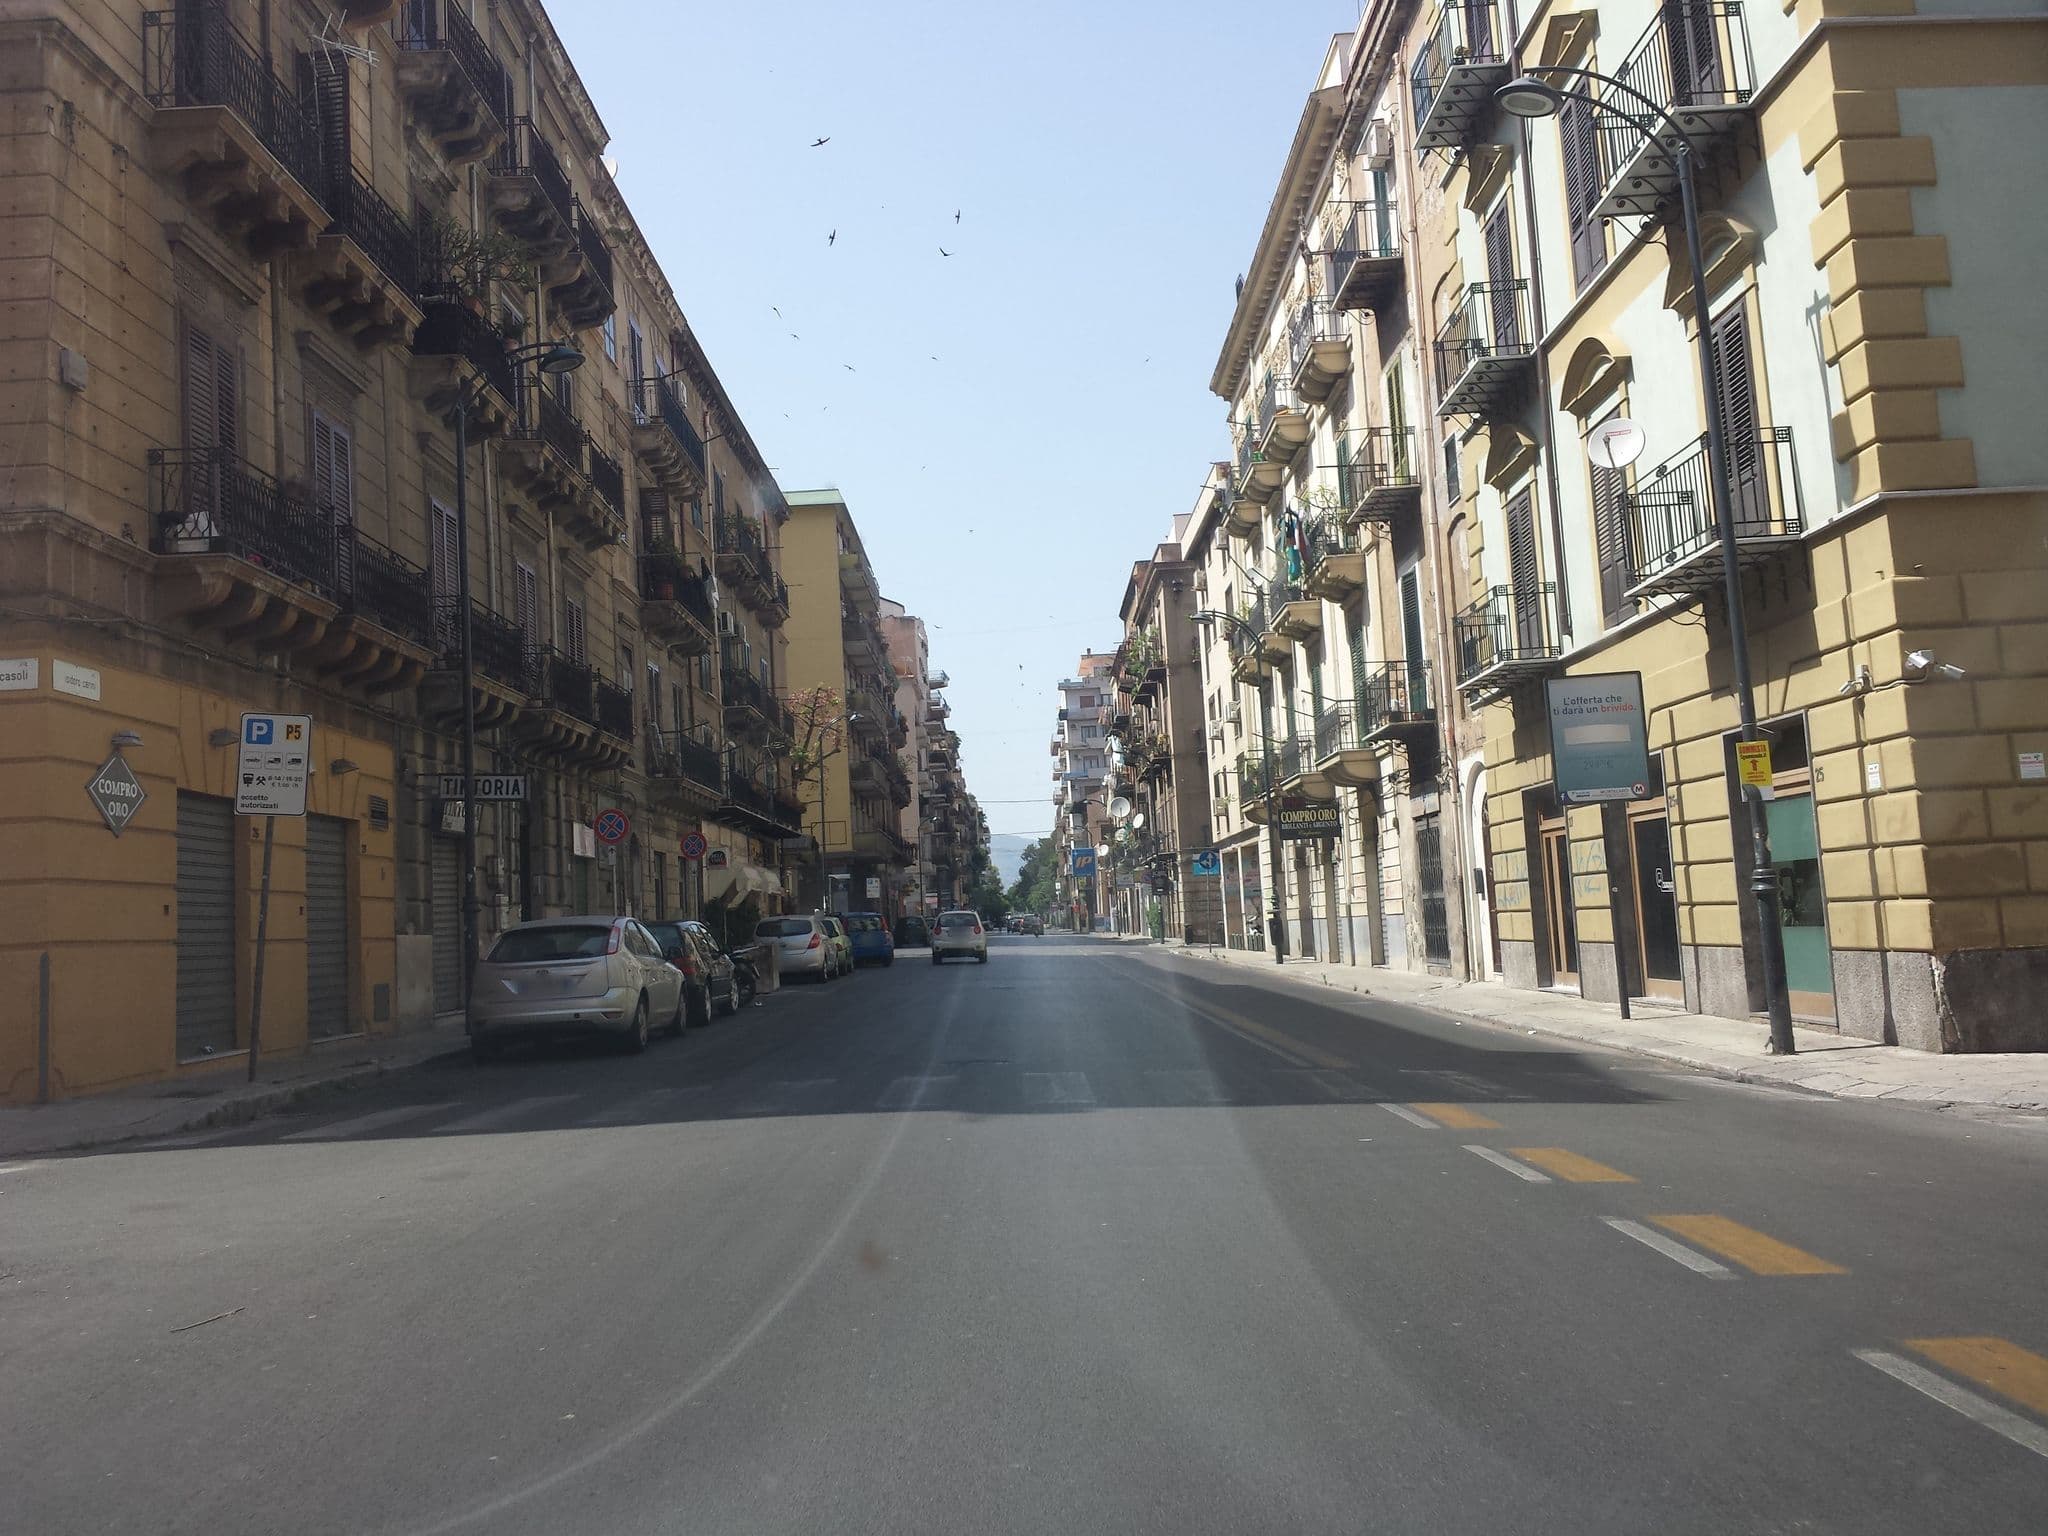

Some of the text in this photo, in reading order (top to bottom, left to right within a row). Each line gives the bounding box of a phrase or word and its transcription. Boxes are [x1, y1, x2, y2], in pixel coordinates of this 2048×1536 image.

[1563, 694, 1622, 706] L'offerta che
[1553, 708, 1560, 716] ti
[1562, 705, 1584, 715] darà
[1586, 705, 1599, 714] un
[252, 722, 303, 742] P P5
[98, 778, 138, 798] COMPRO
[1635, 785, 1643, 793] M
[108, 801, 128, 817] ORO
[1280, 809, 1337, 824] COMPRO ORO
